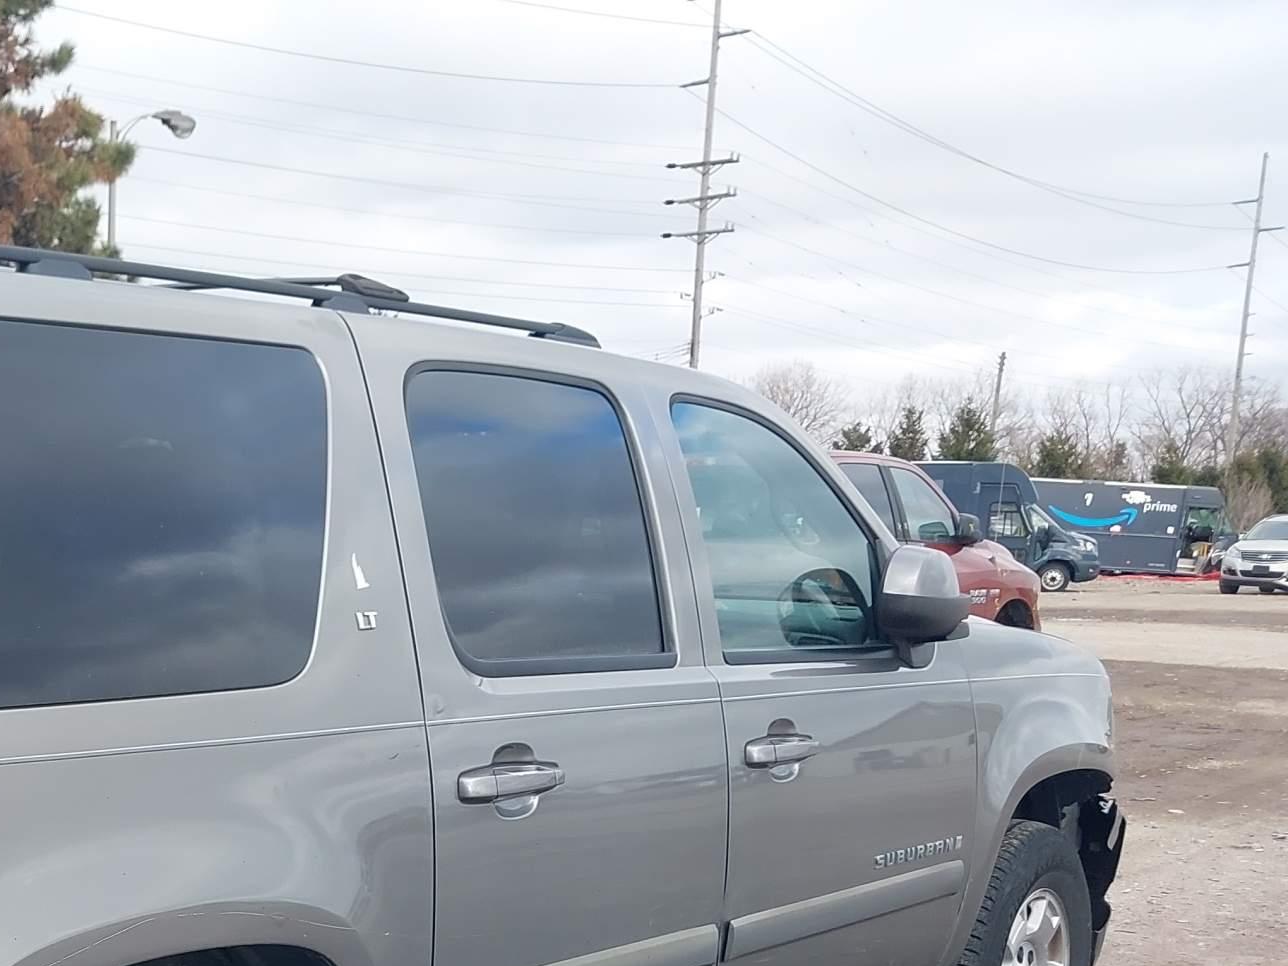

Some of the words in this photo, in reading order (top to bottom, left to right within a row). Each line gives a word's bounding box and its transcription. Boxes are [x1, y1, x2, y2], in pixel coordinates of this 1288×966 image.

[1143, 501, 1178, 512] prime
[355, 611, 378, 630] LT
[873, 837, 954, 869] SUBURBAN
